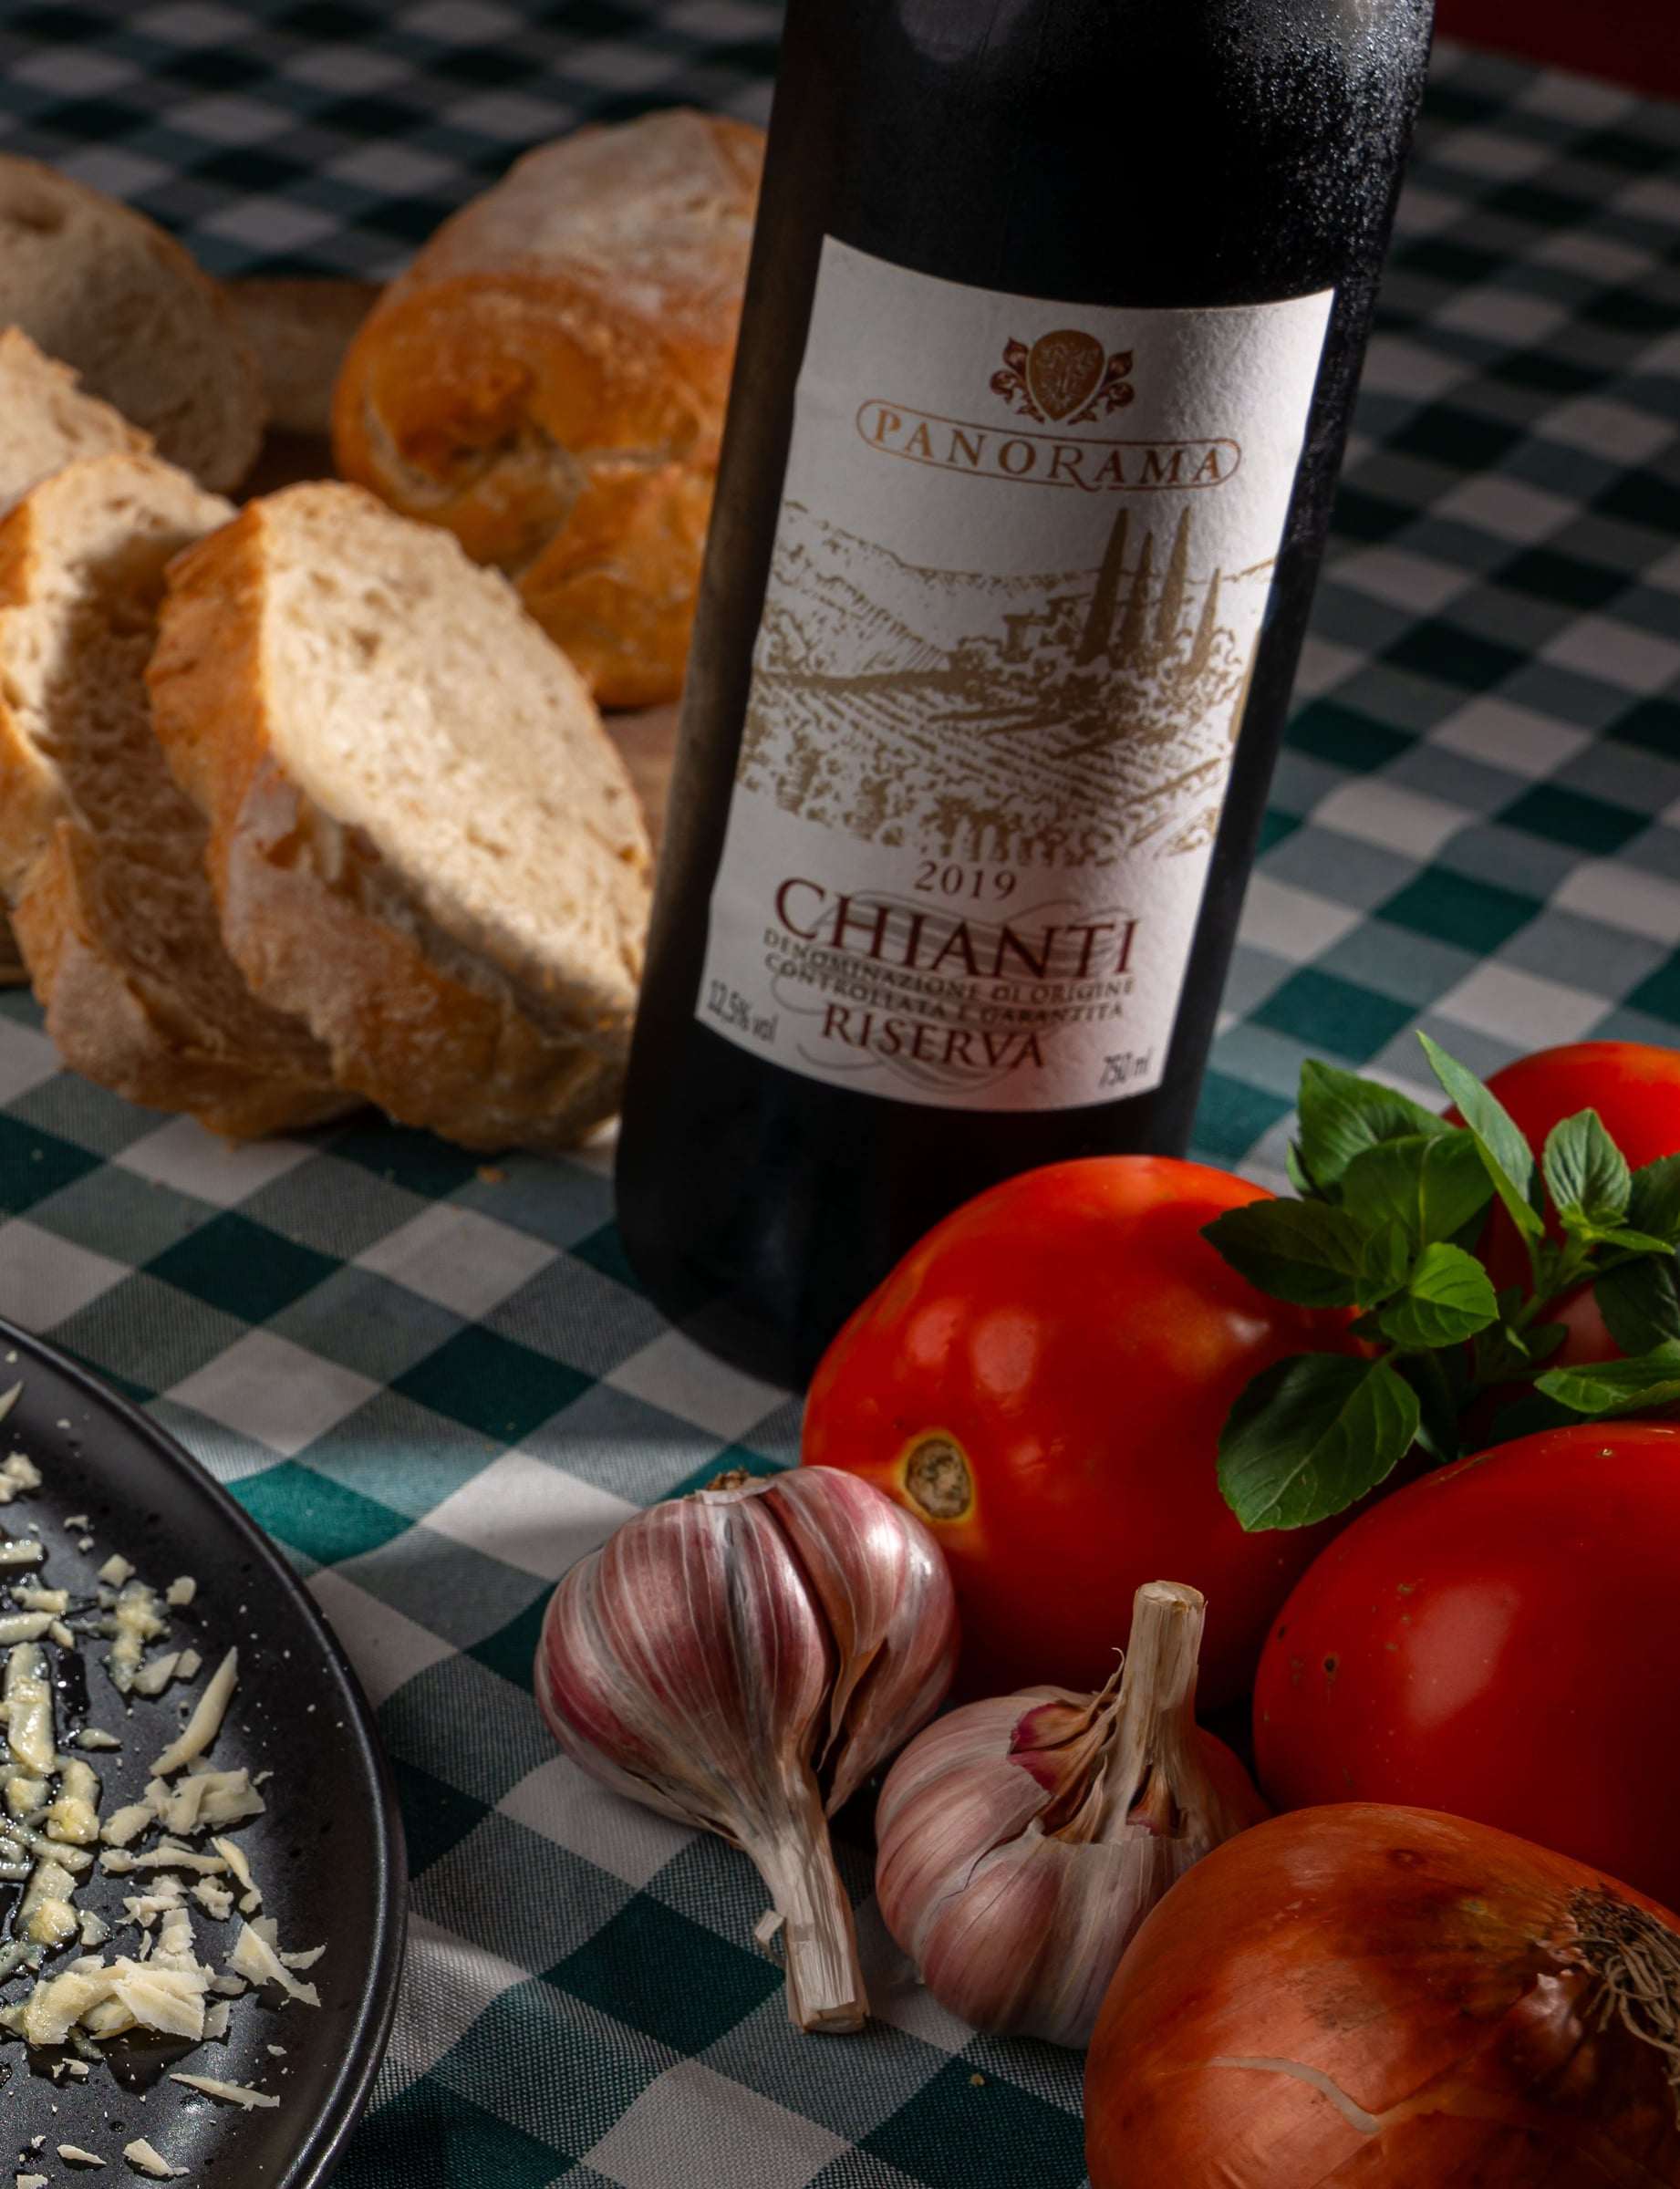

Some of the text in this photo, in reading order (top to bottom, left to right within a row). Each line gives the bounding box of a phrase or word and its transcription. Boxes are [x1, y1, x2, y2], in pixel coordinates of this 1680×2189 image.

[873, 407, 1223, 492] PANORAMA
[915, 861, 1018, 900] 2019
[774, 877, 1142, 980] CHIANTI
[763, 928, 1136, 1004] DENOMINAZIONE DI ORIGINE
[764, 953, 947, 1021] CONTROLLATA
[822, 1003, 1045, 1070] RISERVA
